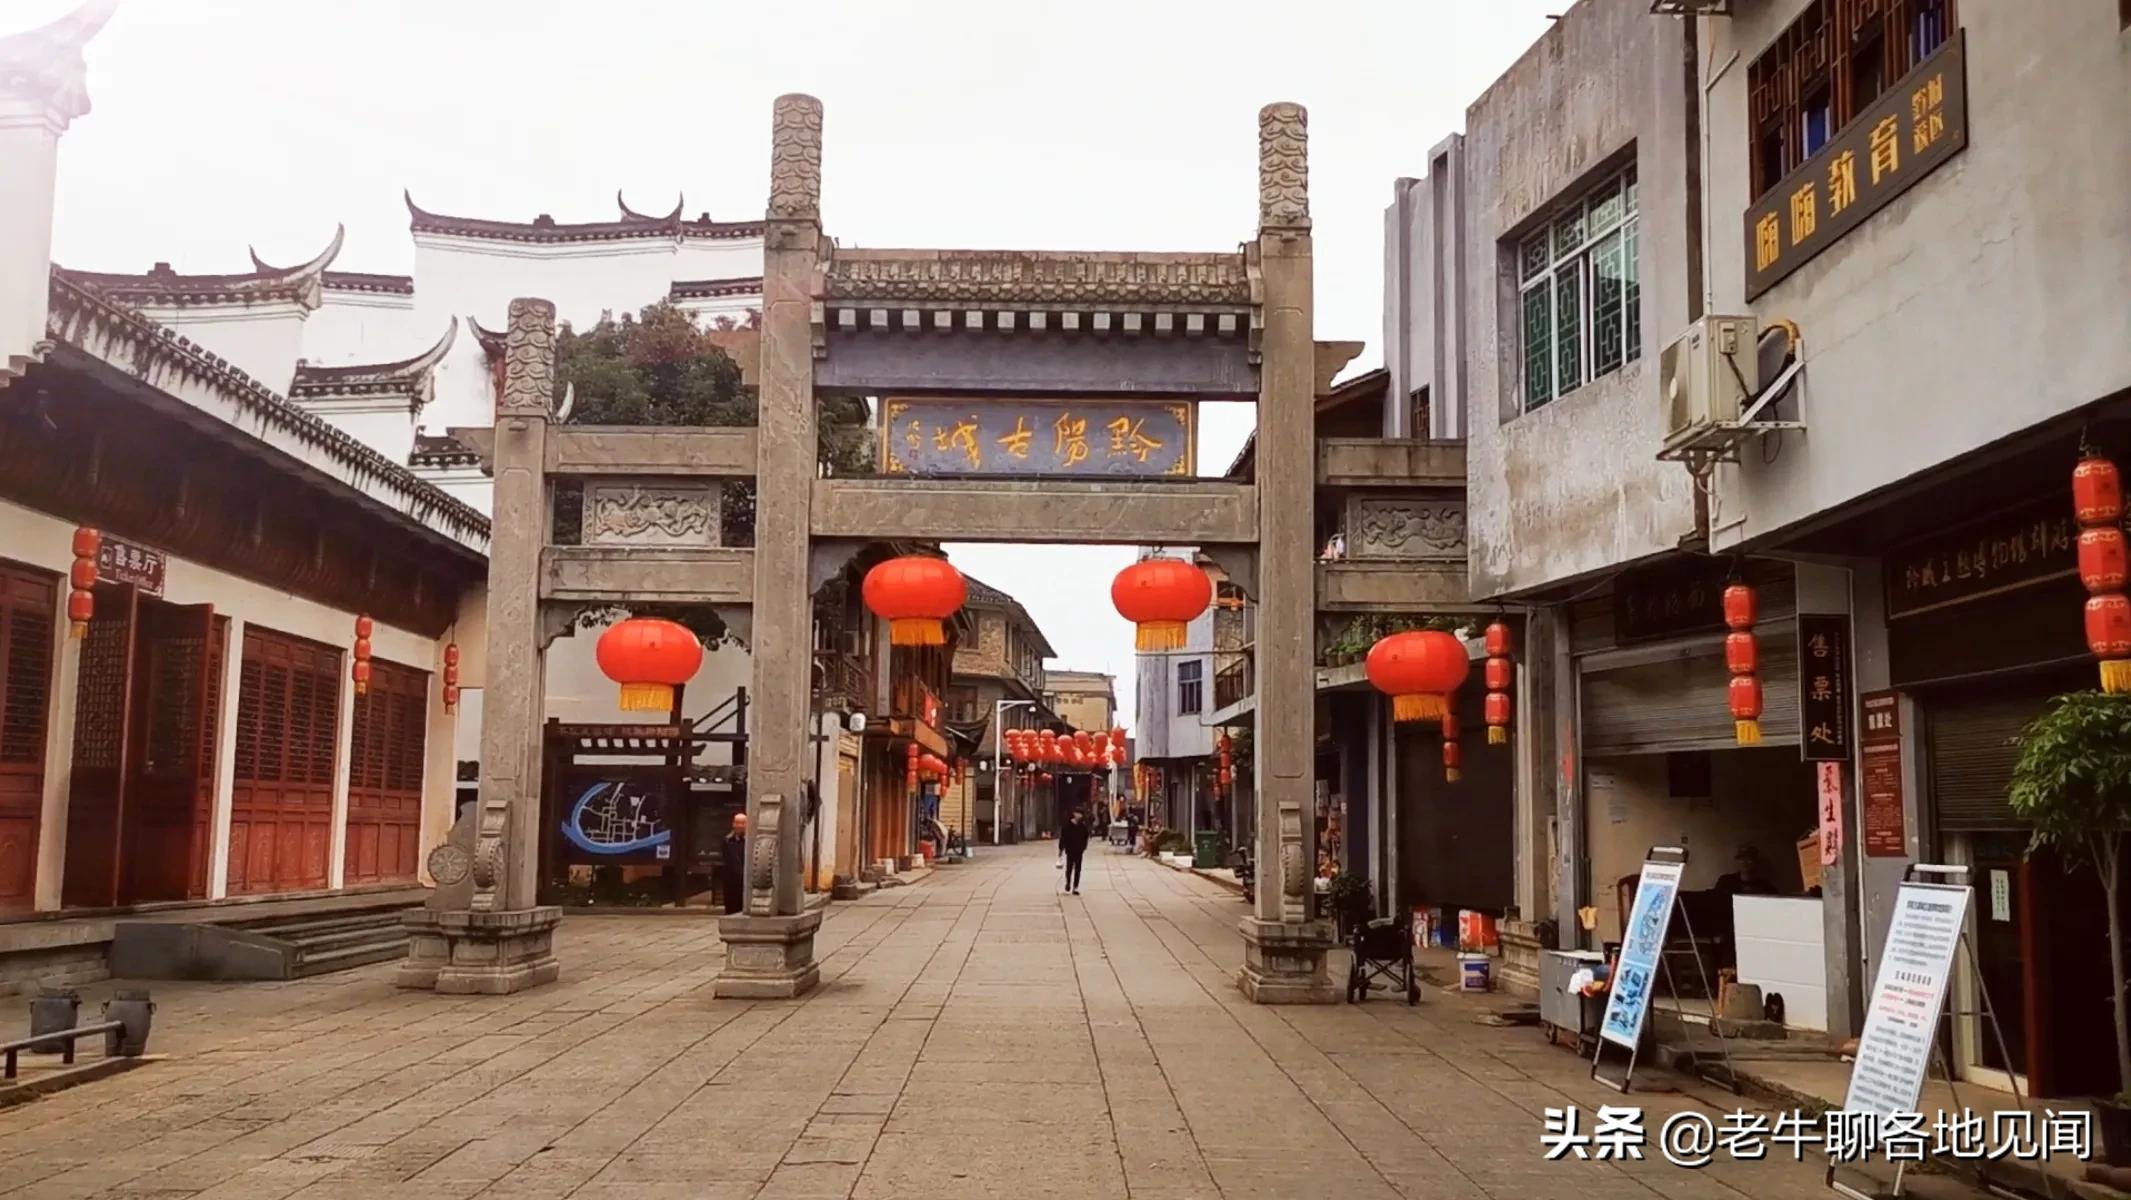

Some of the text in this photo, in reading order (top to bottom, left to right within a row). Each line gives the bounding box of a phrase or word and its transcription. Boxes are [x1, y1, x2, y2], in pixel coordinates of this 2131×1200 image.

[1757, 114, 1898, 272] 嗨嗨教育
[1807, 633, 1833, 744] 售票处
